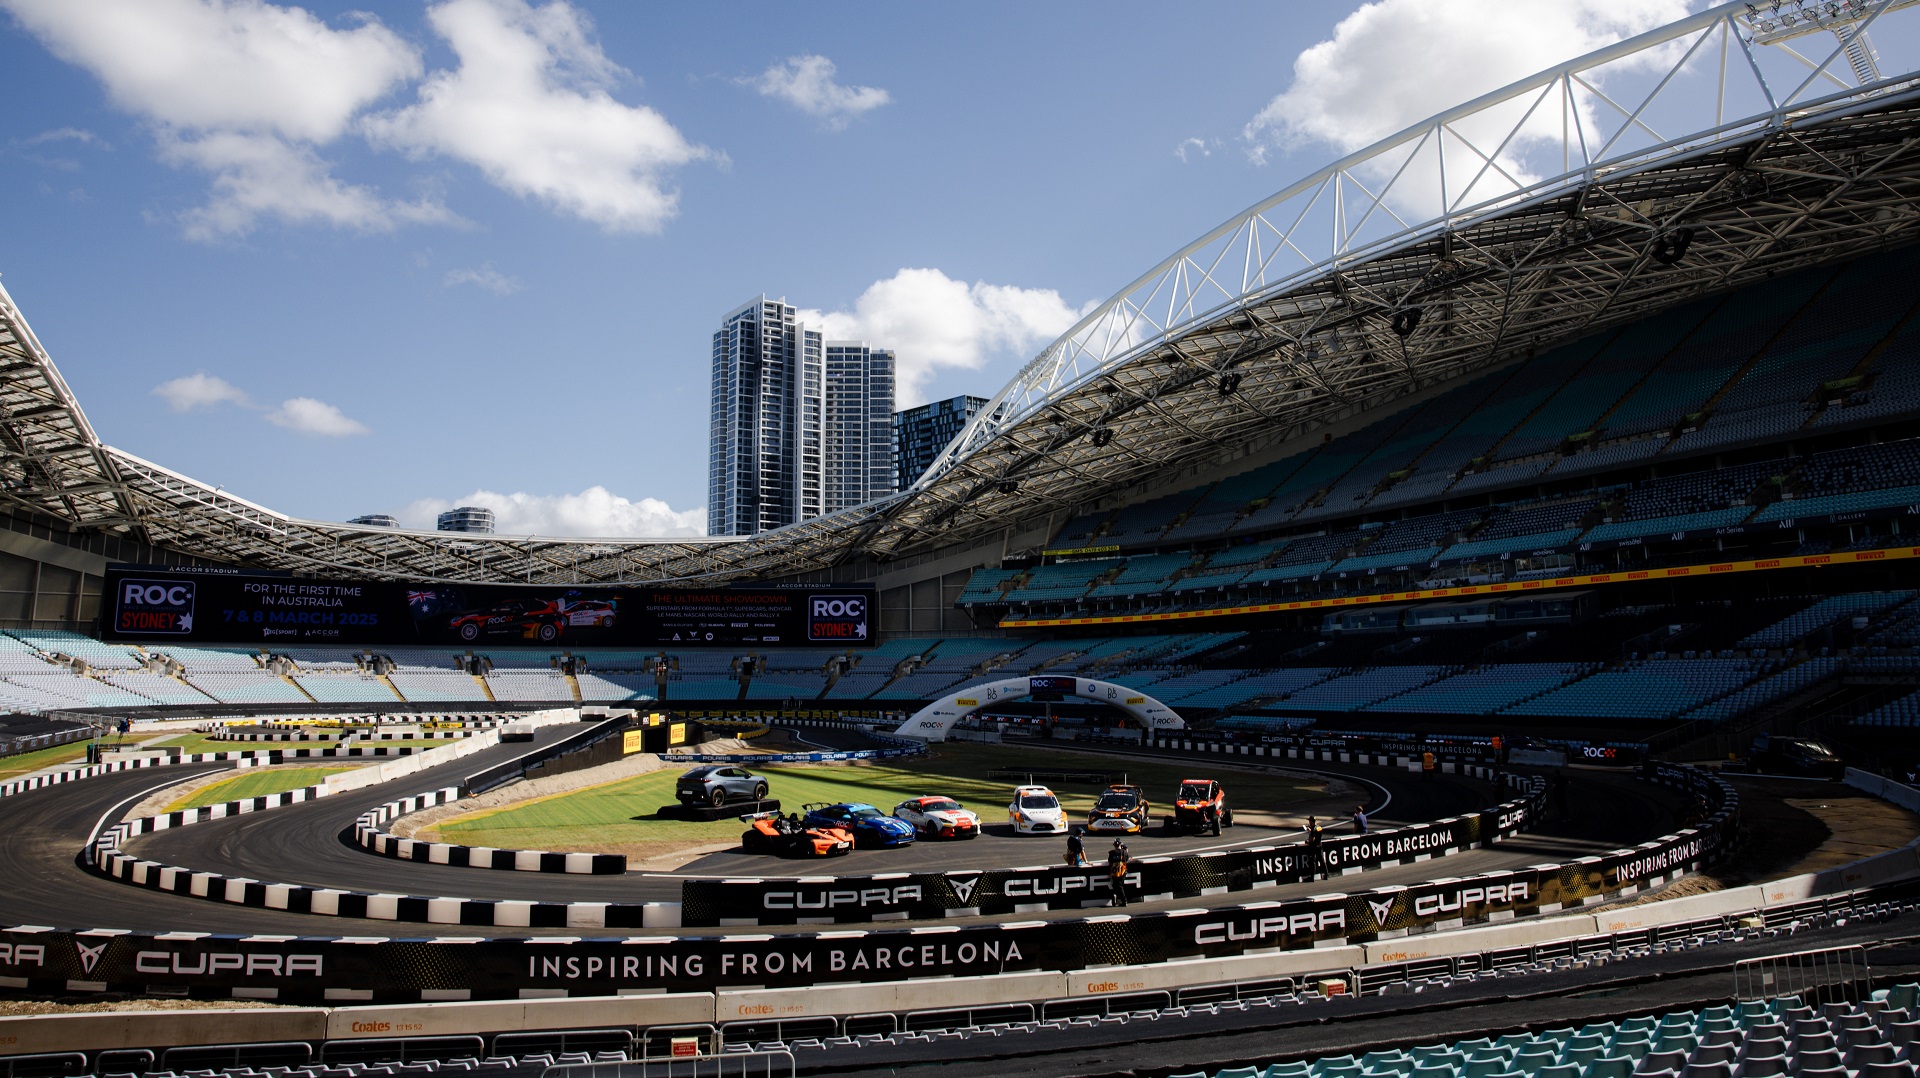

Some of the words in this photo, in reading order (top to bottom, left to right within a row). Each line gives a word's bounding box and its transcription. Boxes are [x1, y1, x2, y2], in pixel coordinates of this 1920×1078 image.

[1837, 512, 1866, 521] GALLERY
[1726, 526, 1744, 534] Series
[1802, 556, 1831, 565] PIRELLI
[1855, 553, 1885, 561] PIRELLI
[1709, 564, 1733, 573] PIRELLI
[1754, 560, 1780, 569] PIRELLI
[204, 567, 239, 575] STADIUM
[1627, 571, 1649, 580] PIRELLI
[1666, 568, 1690, 577] PIRELLI
[1522, 581, 1540, 589] PIRELLI
[1555, 578, 1574, 587] PIRELLI
[1590, 575, 1610, 584] PIRELLI
[124, 584, 187, 606] ROC
[244, 583, 270, 593] FOR
[272, 584, 296, 594] THE
[299, 585, 331, 595] FIRST
[334, 586, 362, 597] TIME
[262, 596, 275, 605] IN
[277, 597, 343, 607] AUSTRALIA
[652, 595, 672, 603] THE
[675, 595, 721, 603] ULTIMATE
[723, 596, 787, 604] SHOWDOWN
[813, 600, 861, 617] ROC
[121, 611, 177, 629] SYDNEY
[223, 610, 234, 623] 7
[238, 610, 249, 623] &
[252, 611, 264, 623] 8
[269, 611, 334, 625] MARCH
[338, 612, 379, 626] 2025
[813, 623, 854, 637] SYDNEY
[625, 735, 640, 748] PIRELLI
[1261, 736, 1293, 744] CUPRA
[1309, 739, 1345, 747] CUPRA
[1381, 743, 1415, 752] INSPIRING
[1439, 744, 1482, 755] BARCELONA
[1656, 766, 1685, 781] CUPRA
[1498, 807, 1528, 829] CUPRA
[1343, 842, 1381, 862] FROM
[1387, 829, 1453, 856] BARCELONA
[1616, 852, 1667, 882] INSPIRING
[1668, 844, 1689, 866] FROM
[764, 885, 922, 910] CUPRA
[1415, 881, 1529, 917] CUPRA
[1194, 908, 1345, 944] CUPRA
[135, 951, 323, 977] CUPRA
[528, 954, 705, 979] INSPIRING
[721, 952, 813, 976] FROM
[830, 940, 1023, 972] BARCELONA
[1087, 981, 1119, 993] Coates
[738, 1004, 774, 1015] Coates
[351, 1020, 391, 1033] Coates
[413, 1023, 423, 1031] 52
